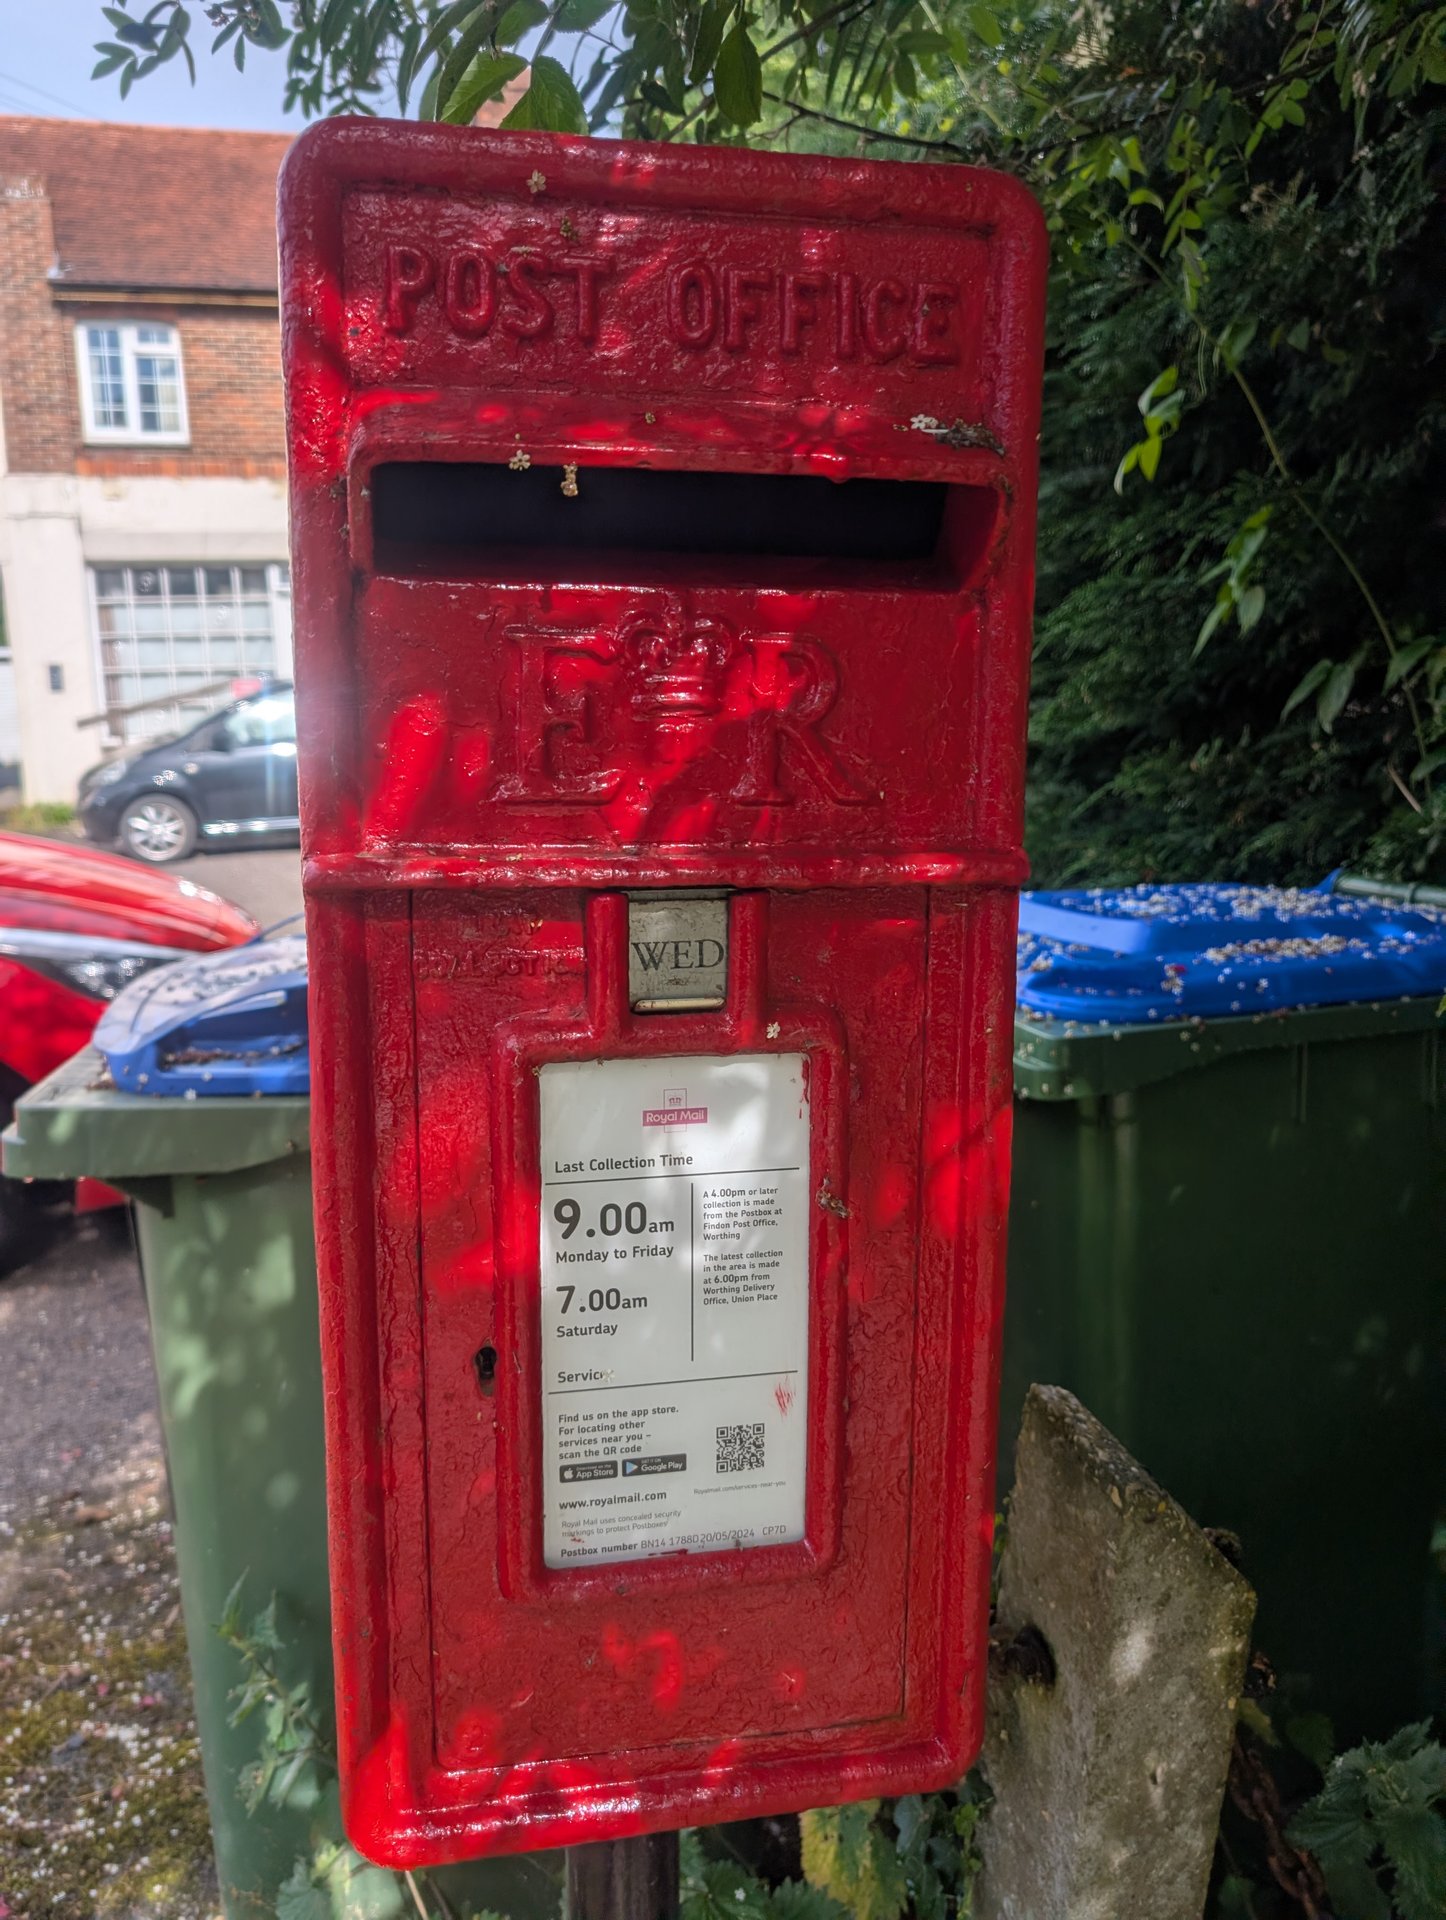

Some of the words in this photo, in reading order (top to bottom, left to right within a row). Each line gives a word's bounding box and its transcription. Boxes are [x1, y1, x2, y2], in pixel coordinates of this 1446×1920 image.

[382, 244, 612, 347] POST
[667, 263, 961, 367] OFFICE
[632, 938, 725, 972] WED
[646, 1111, 678, 1124] Royal
[680, 1109, 705, 1121] Mail
[555, 1161, 584, 1174] Last
[589, 1156, 656, 1171] Collection
[660, 1154, 693, 1167] Time
[703, 1191, 709, 1199] A
[711, 1188, 746, 1198] 4.00pm
[759, 1187, 779, 1195] later
[703, 1199, 741, 1209] collection
[753, 1198, 775, 1206] made
[553, 1198, 675, 1240] 9.00am
[703, 1212, 723, 1220] from
[725, 1210, 738, 1218] the
[741, 1208, 772, 1218] Postbox
[703, 1221, 730, 1230] Findon
[733, 1220, 750, 1228] Post
[703, 1231, 740, 1241] Worthing
[556, 1250, 609, 1264] Monday
[614, 1248, 627, 1260] to
[632, 1244, 674, 1258] Friday
[703, 1254, 719, 1262] The
[720, 1252, 743, 1261] latest
[745, 1249, 783, 1259] collection
[713, 1263, 727, 1272] the
[758, 1260, 780, 1268] made
[703, 1277, 712, 1285] at
[714, 1274, 749, 1284] 6.00pm
[751, 1273, 770, 1281] from
[703, 1285, 741, 1295] Worthing
[743, 1283, 775, 1292] Delivery
[556, 1285, 648, 1314] 7.00am
[731, 1295, 755, 1303] Union
[757, 1293, 778, 1301] Place
[556, 1322, 618, 1338] Saturday
[558, 1413, 579, 1423] Find
[583, 1414, 593, 1422] us
[597, 1412, 609, 1420] on
[612, 1409, 628, 1418] the
[631, 1408, 649, 1418] app
[651, 1405, 679, 1415] store.
[558, 1426, 574, 1436] For
[577, 1423, 616, 1434] locating
[619, 1420, 645, 1430] other
[558, 1437, 598, 1448] services
[601, 1435, 623, 1443] near
[625, 1433, 643, 1443] you
[558, 1450, 581, 1460] scan
[584, 1447, 600, 1457] the
[603, 1446, 617, 1456] QR
[620, 1444, 642, 1454] code
[576, 1470, 592, 1479] App
[593, 1468, 613, 1476] Store
[640, 1463, 667, 1472] Google
[668, 1461, 683, 1470] Play
[558, 1490, 667, 1510] www.royalmail.com
[561, 1519, 580, 1529] Royal
[583, 1517, 597, 1526] Mail
[600, 1517, 615, 1525] uses
[618, 1513, 652, 1523] concealed
[654, 1510, 681, 1520] security
[561, 1526, 594, 1538] markings
[605, 1524, 631, 1535] protect
[560, 1547, 598, 1559] Postbox
[601, 1541, 638, 1553] number
[640, 1537, 666, 1549] BN14
[700, 1528, 755, 1544] 20/05/2024
[762, 1524, 787, 1536] CP7D
